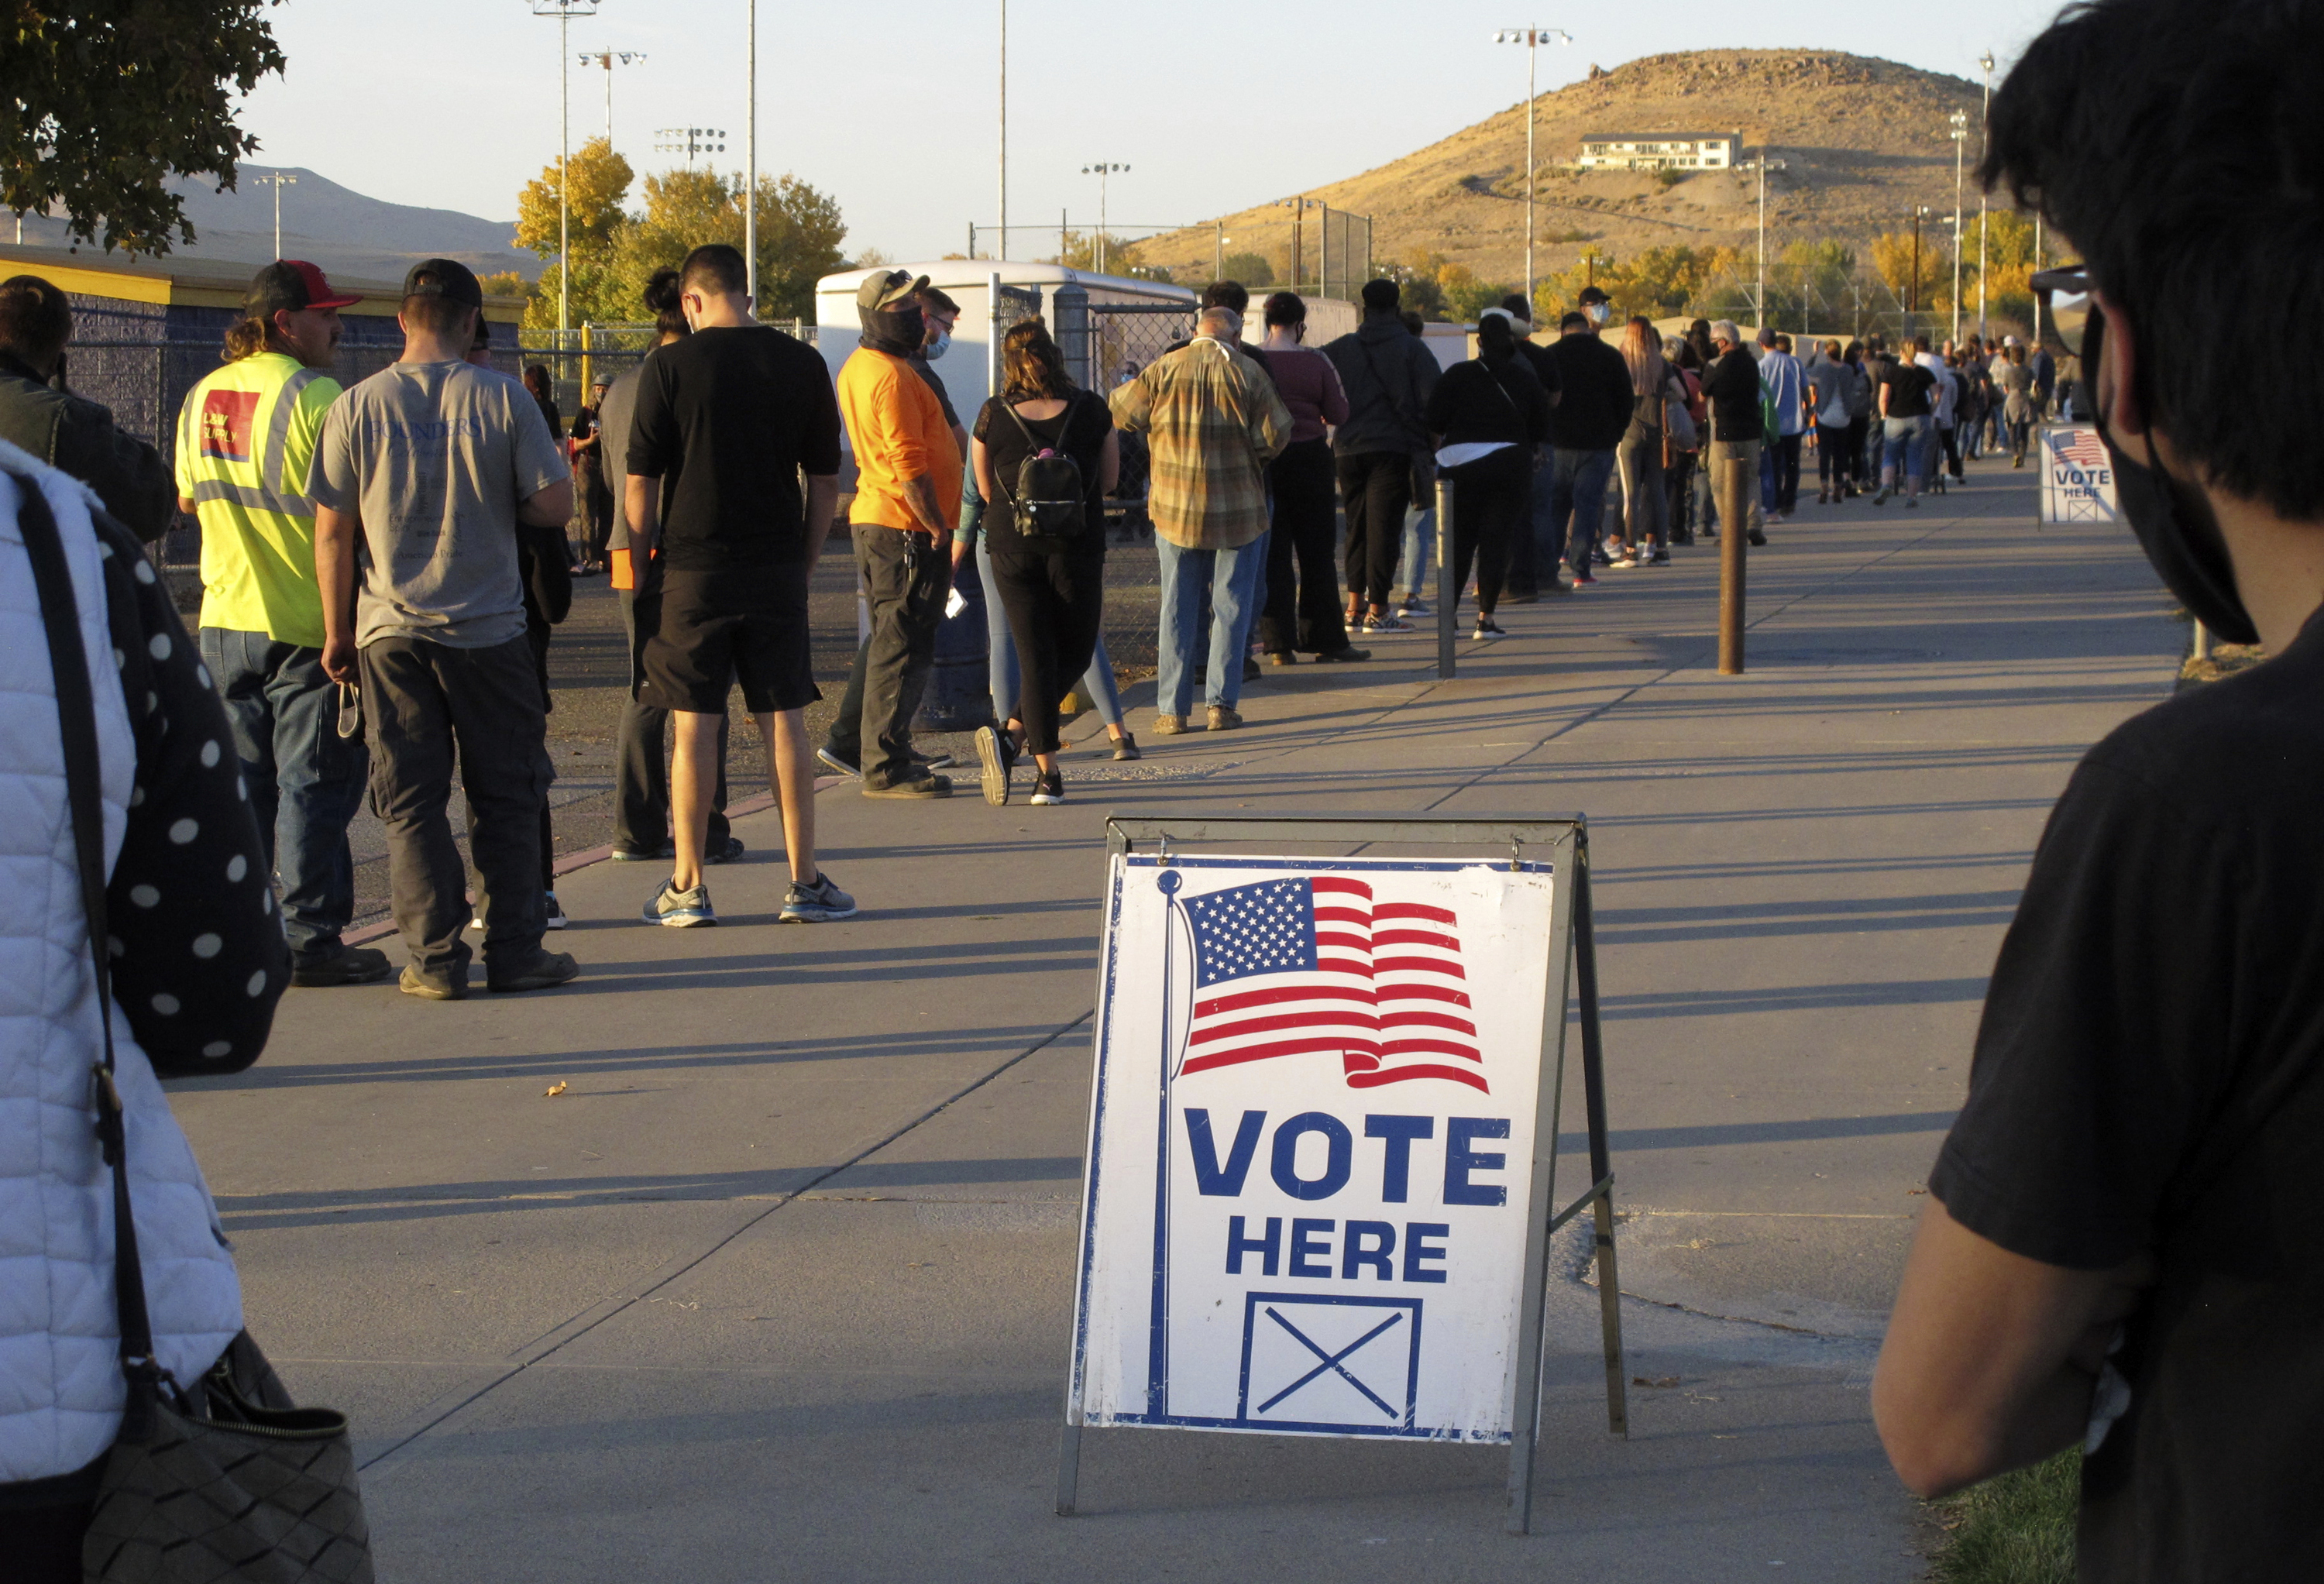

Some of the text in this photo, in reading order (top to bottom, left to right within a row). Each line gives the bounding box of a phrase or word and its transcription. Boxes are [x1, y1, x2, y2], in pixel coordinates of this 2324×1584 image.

[204, 413, 229, 426] L&W
[204, 427, 237, 443] SUPPLY
[370, 416, 481, 442] FOUNDERS
[2056, 469, 2110, 485] VOTE
[2064, 488, 2101, 498] HERE
[1184, 1108, 1511, 1206] VOTE
[1226, 1215, 1449, 1283] HERE
